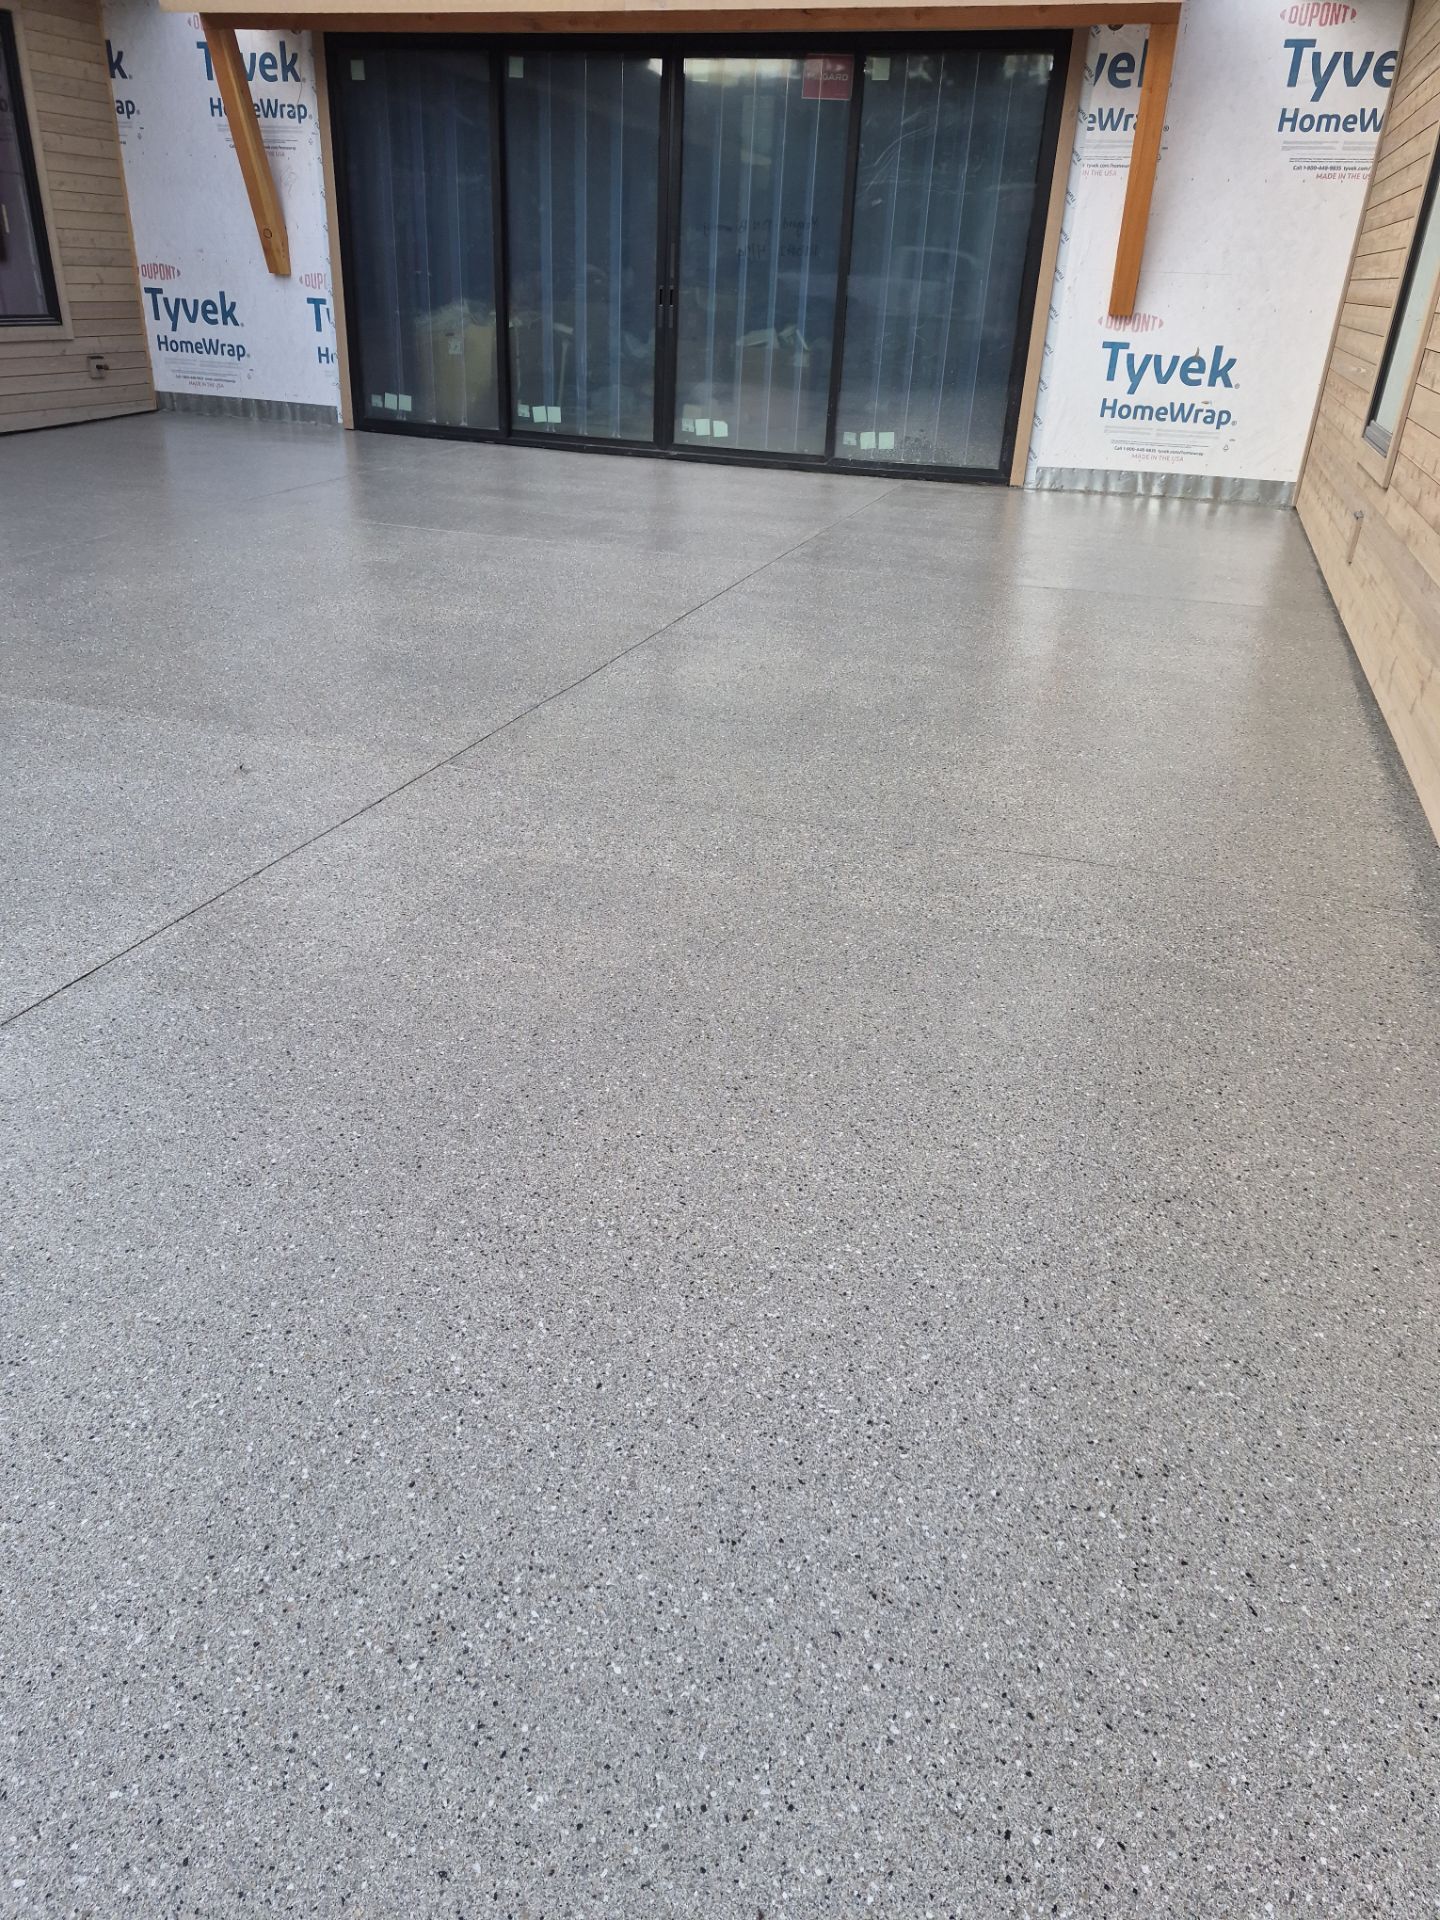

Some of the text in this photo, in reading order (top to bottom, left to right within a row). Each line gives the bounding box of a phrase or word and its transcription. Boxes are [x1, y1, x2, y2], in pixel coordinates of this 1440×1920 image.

[1288, 2, 1349, 27] DUPONT
[197, 41, 301, 82] Tvek
[209, 97, 307, 124] HeWrap
[1091, 169, 1103, 177] THE
[1104, 169, 1117, 177] USA
[141, 263, 176, 280] DUPONT
[144, 287, 240, 332] Tyvek
[156, 334, 247, 361] HomeWrap
[1102, 341, 1237, 395] Tyvek
[1100, 398, 1232, 430] HomeWrap
[1131, 452, 1150, 460] MADE
